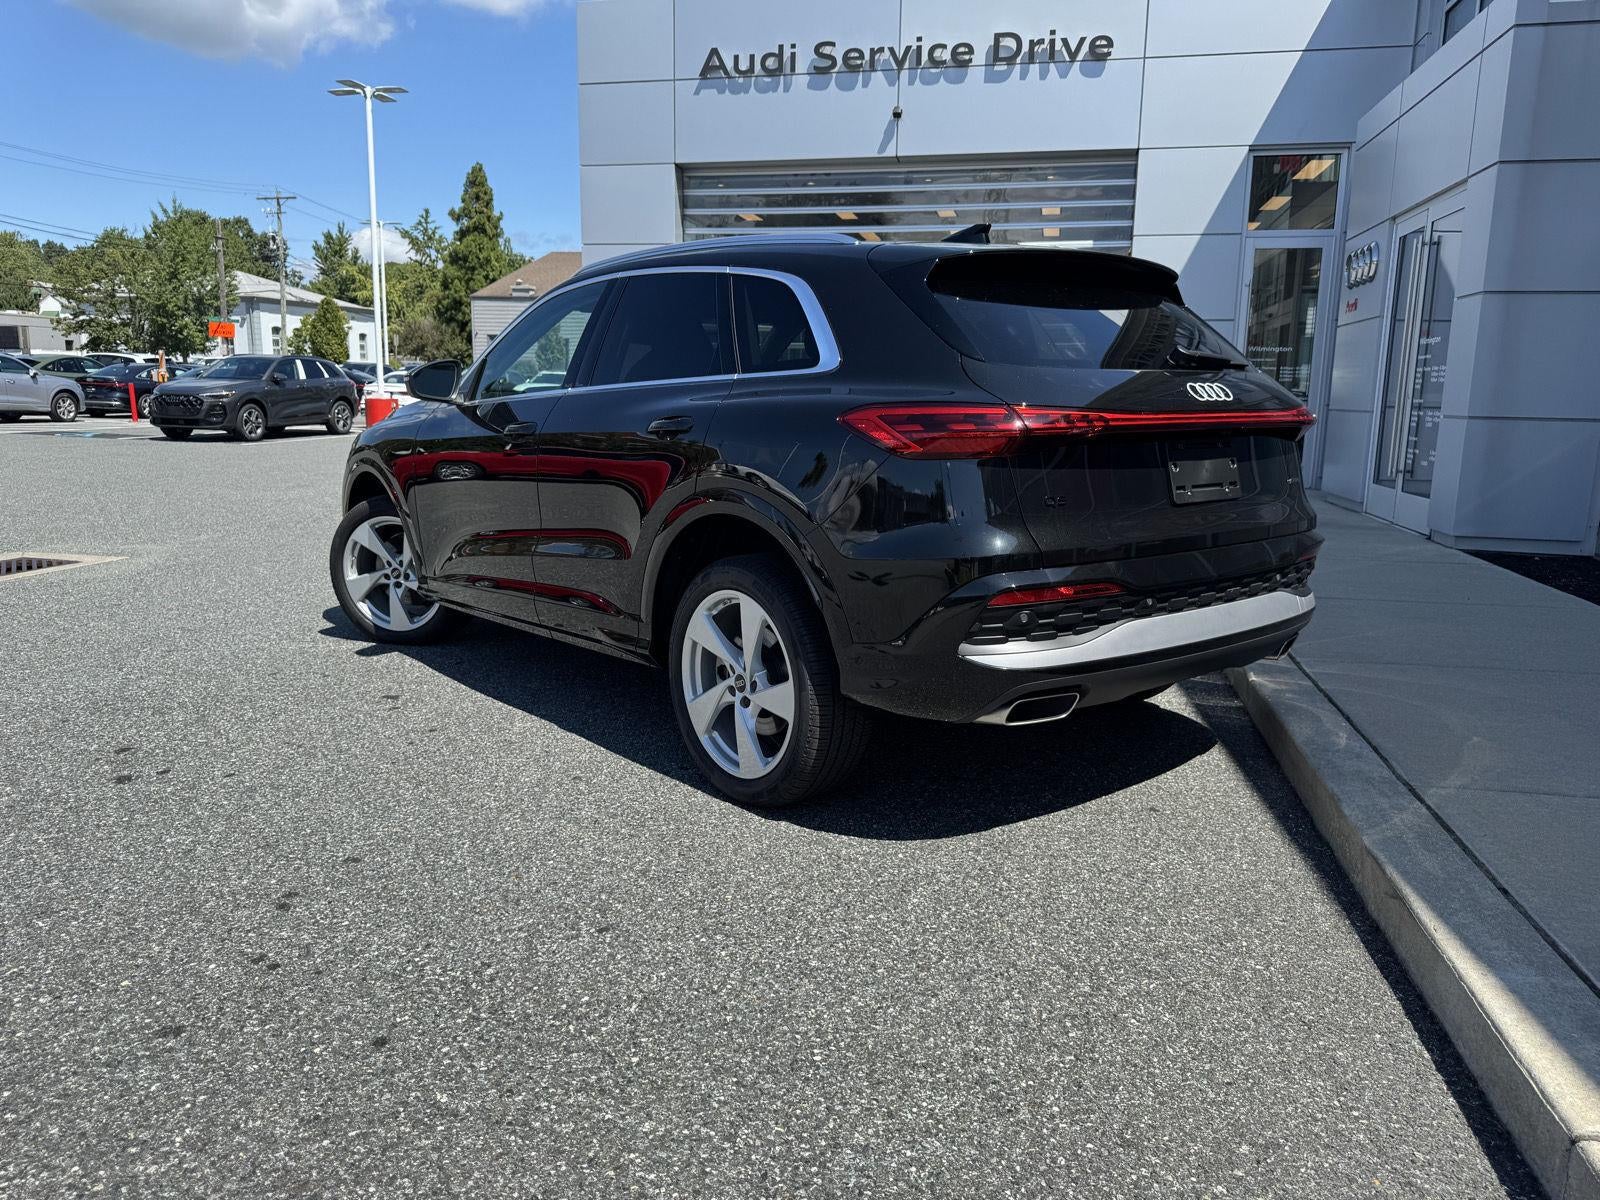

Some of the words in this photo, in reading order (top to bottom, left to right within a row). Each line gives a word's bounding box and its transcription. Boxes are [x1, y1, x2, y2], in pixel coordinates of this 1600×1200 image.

[699, 43, 797, 77] Audi
[813, 36, 975, 73] Service
[992, 29, 1114, 65] Drive
[1247, 345, 1294, 353] Wilmington
